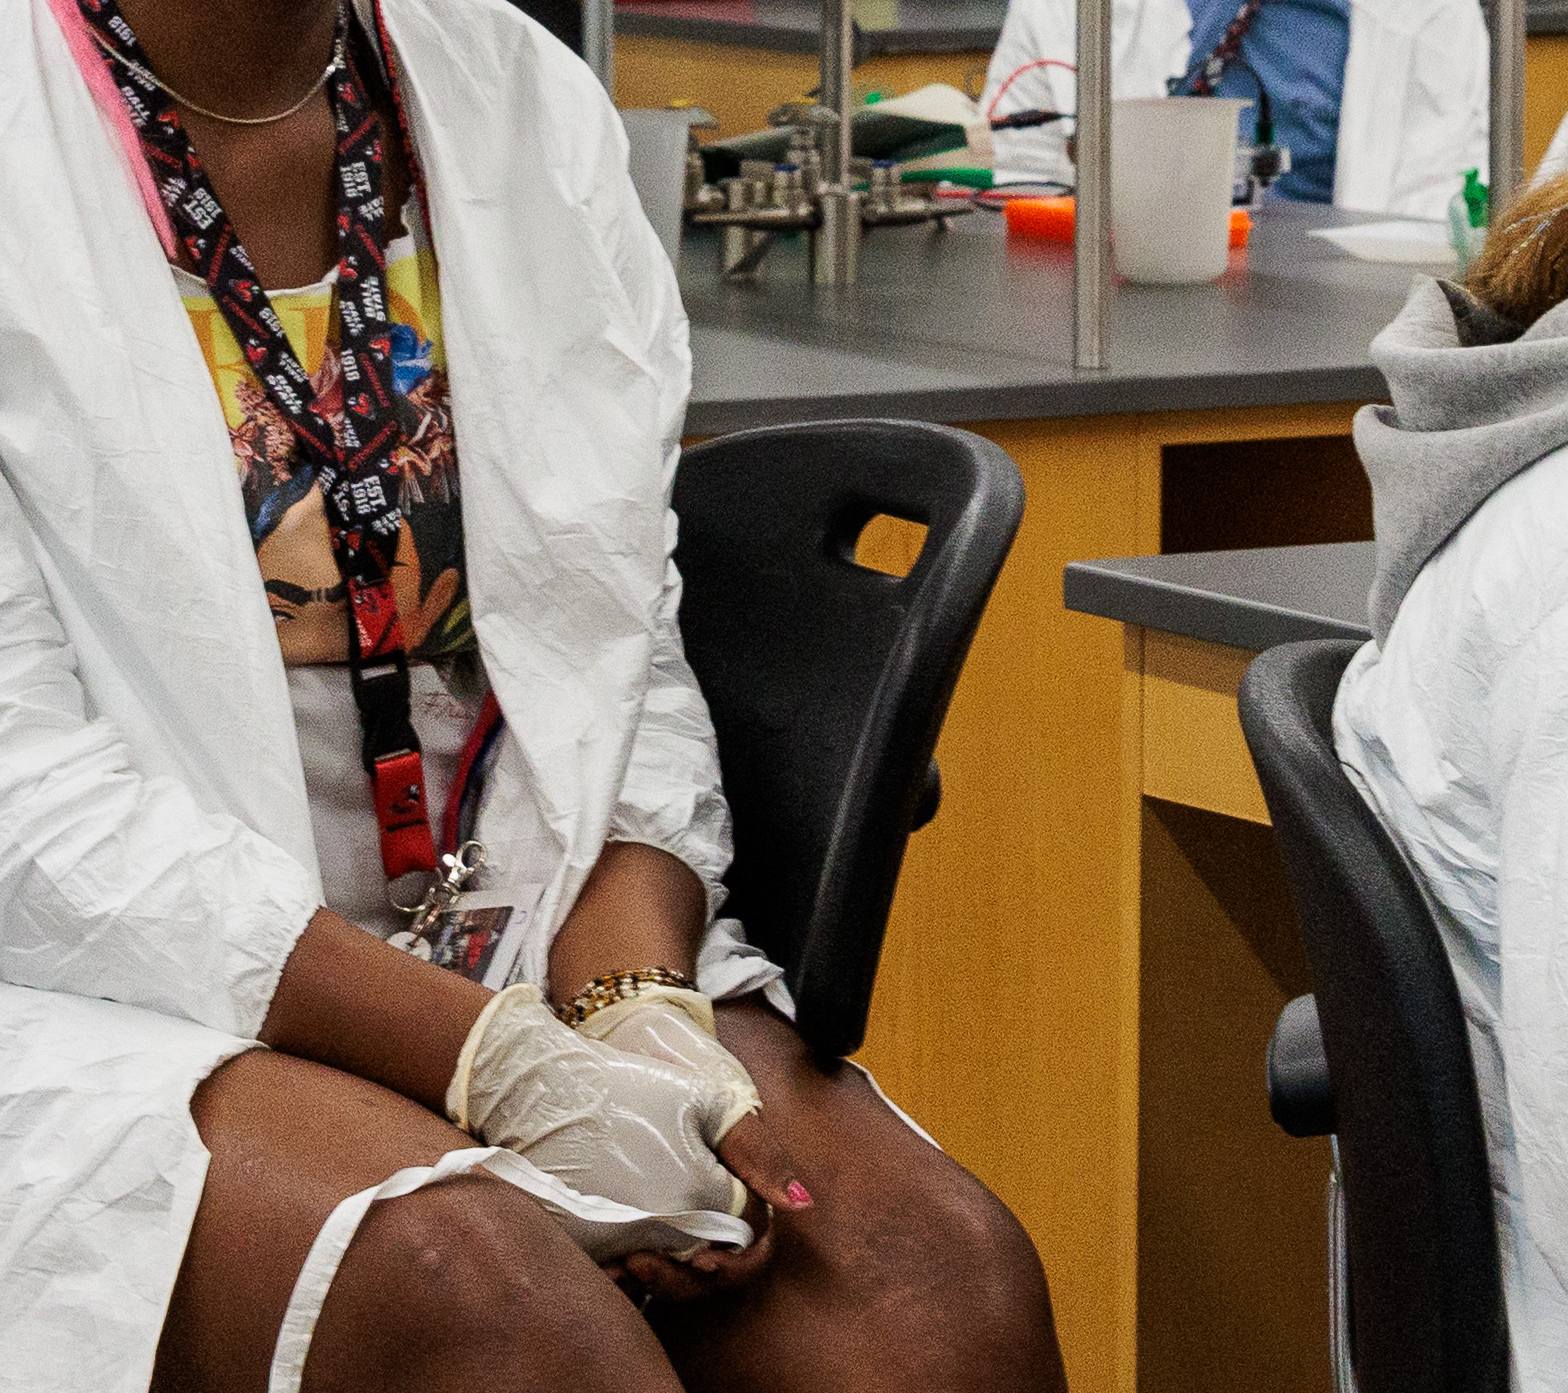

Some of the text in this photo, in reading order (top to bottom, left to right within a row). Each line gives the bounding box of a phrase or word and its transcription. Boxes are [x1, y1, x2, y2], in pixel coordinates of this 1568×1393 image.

[121, 86, 151, 118] BALL
[341, 348, 361, 382] 1918
[274, 374, 303, 407] BALL
[351, 482, 371, 515] 1918
